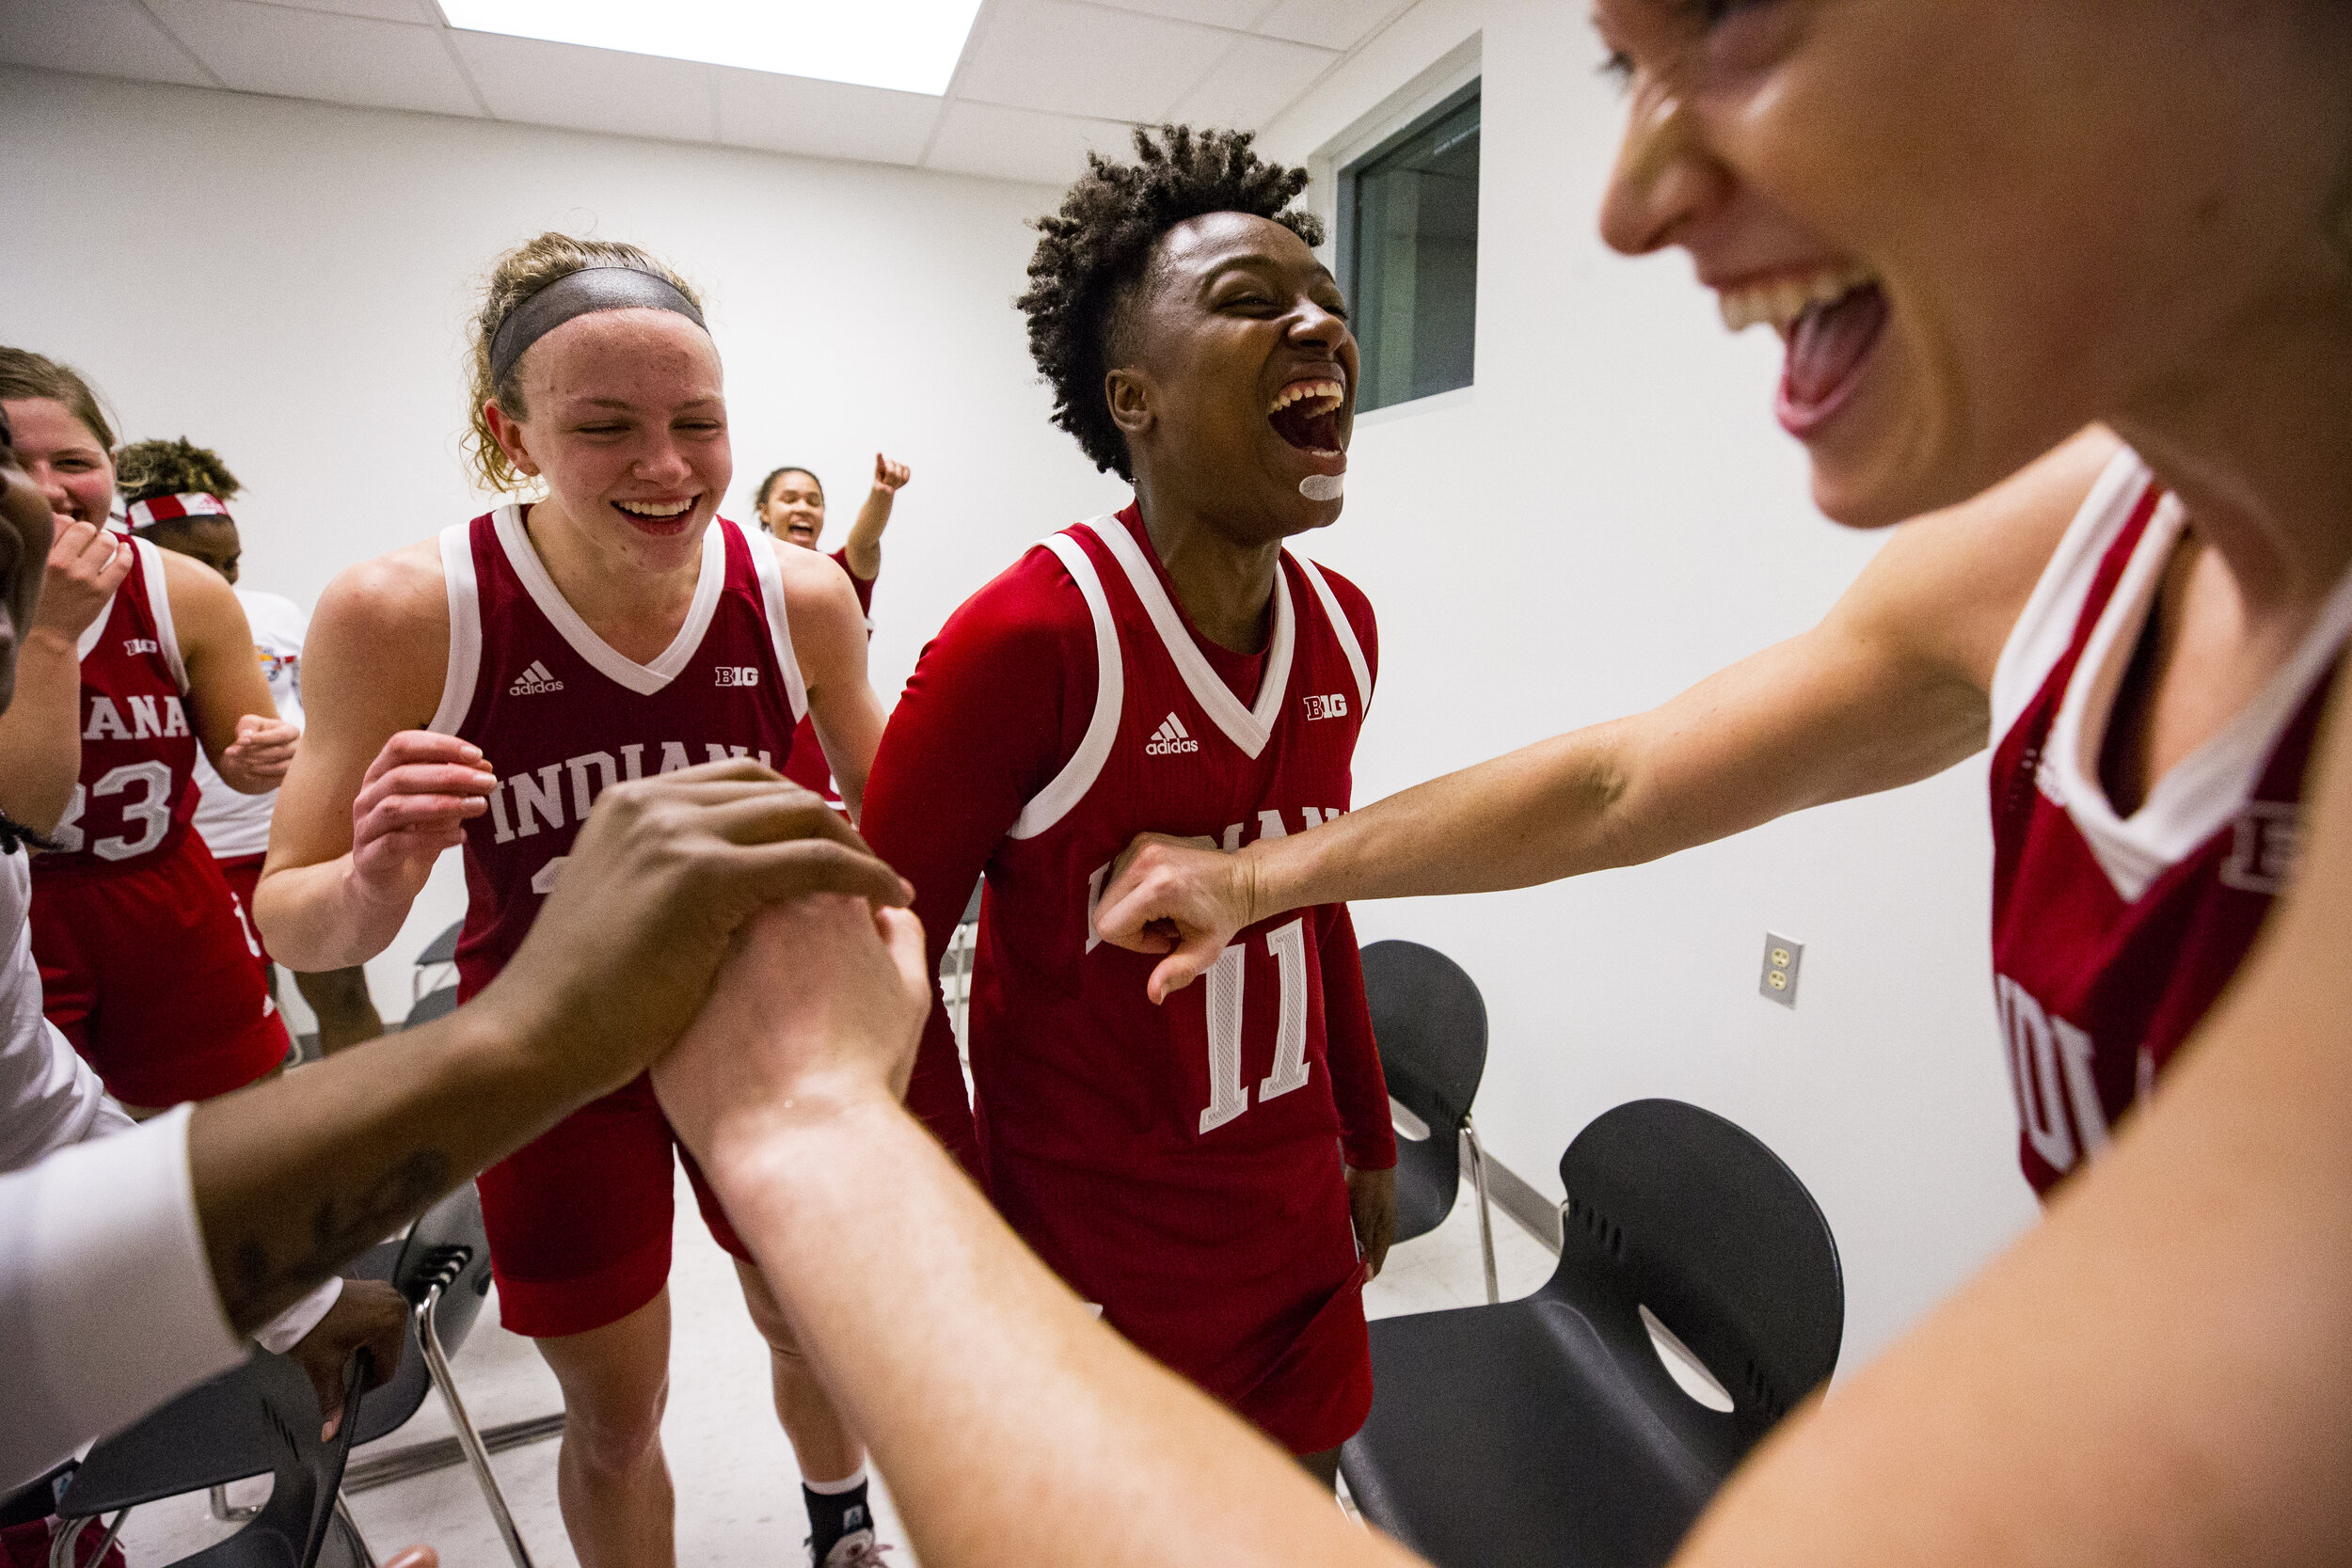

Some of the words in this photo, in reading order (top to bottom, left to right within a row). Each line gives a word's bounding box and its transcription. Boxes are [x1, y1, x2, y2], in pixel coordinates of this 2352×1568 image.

[509, 680, 564, 696] adidas
[1145, 737, 1200, 755] adidas
[489, 740, 772, 845] INDI
[1196, 916, 1311, 1137] 11
